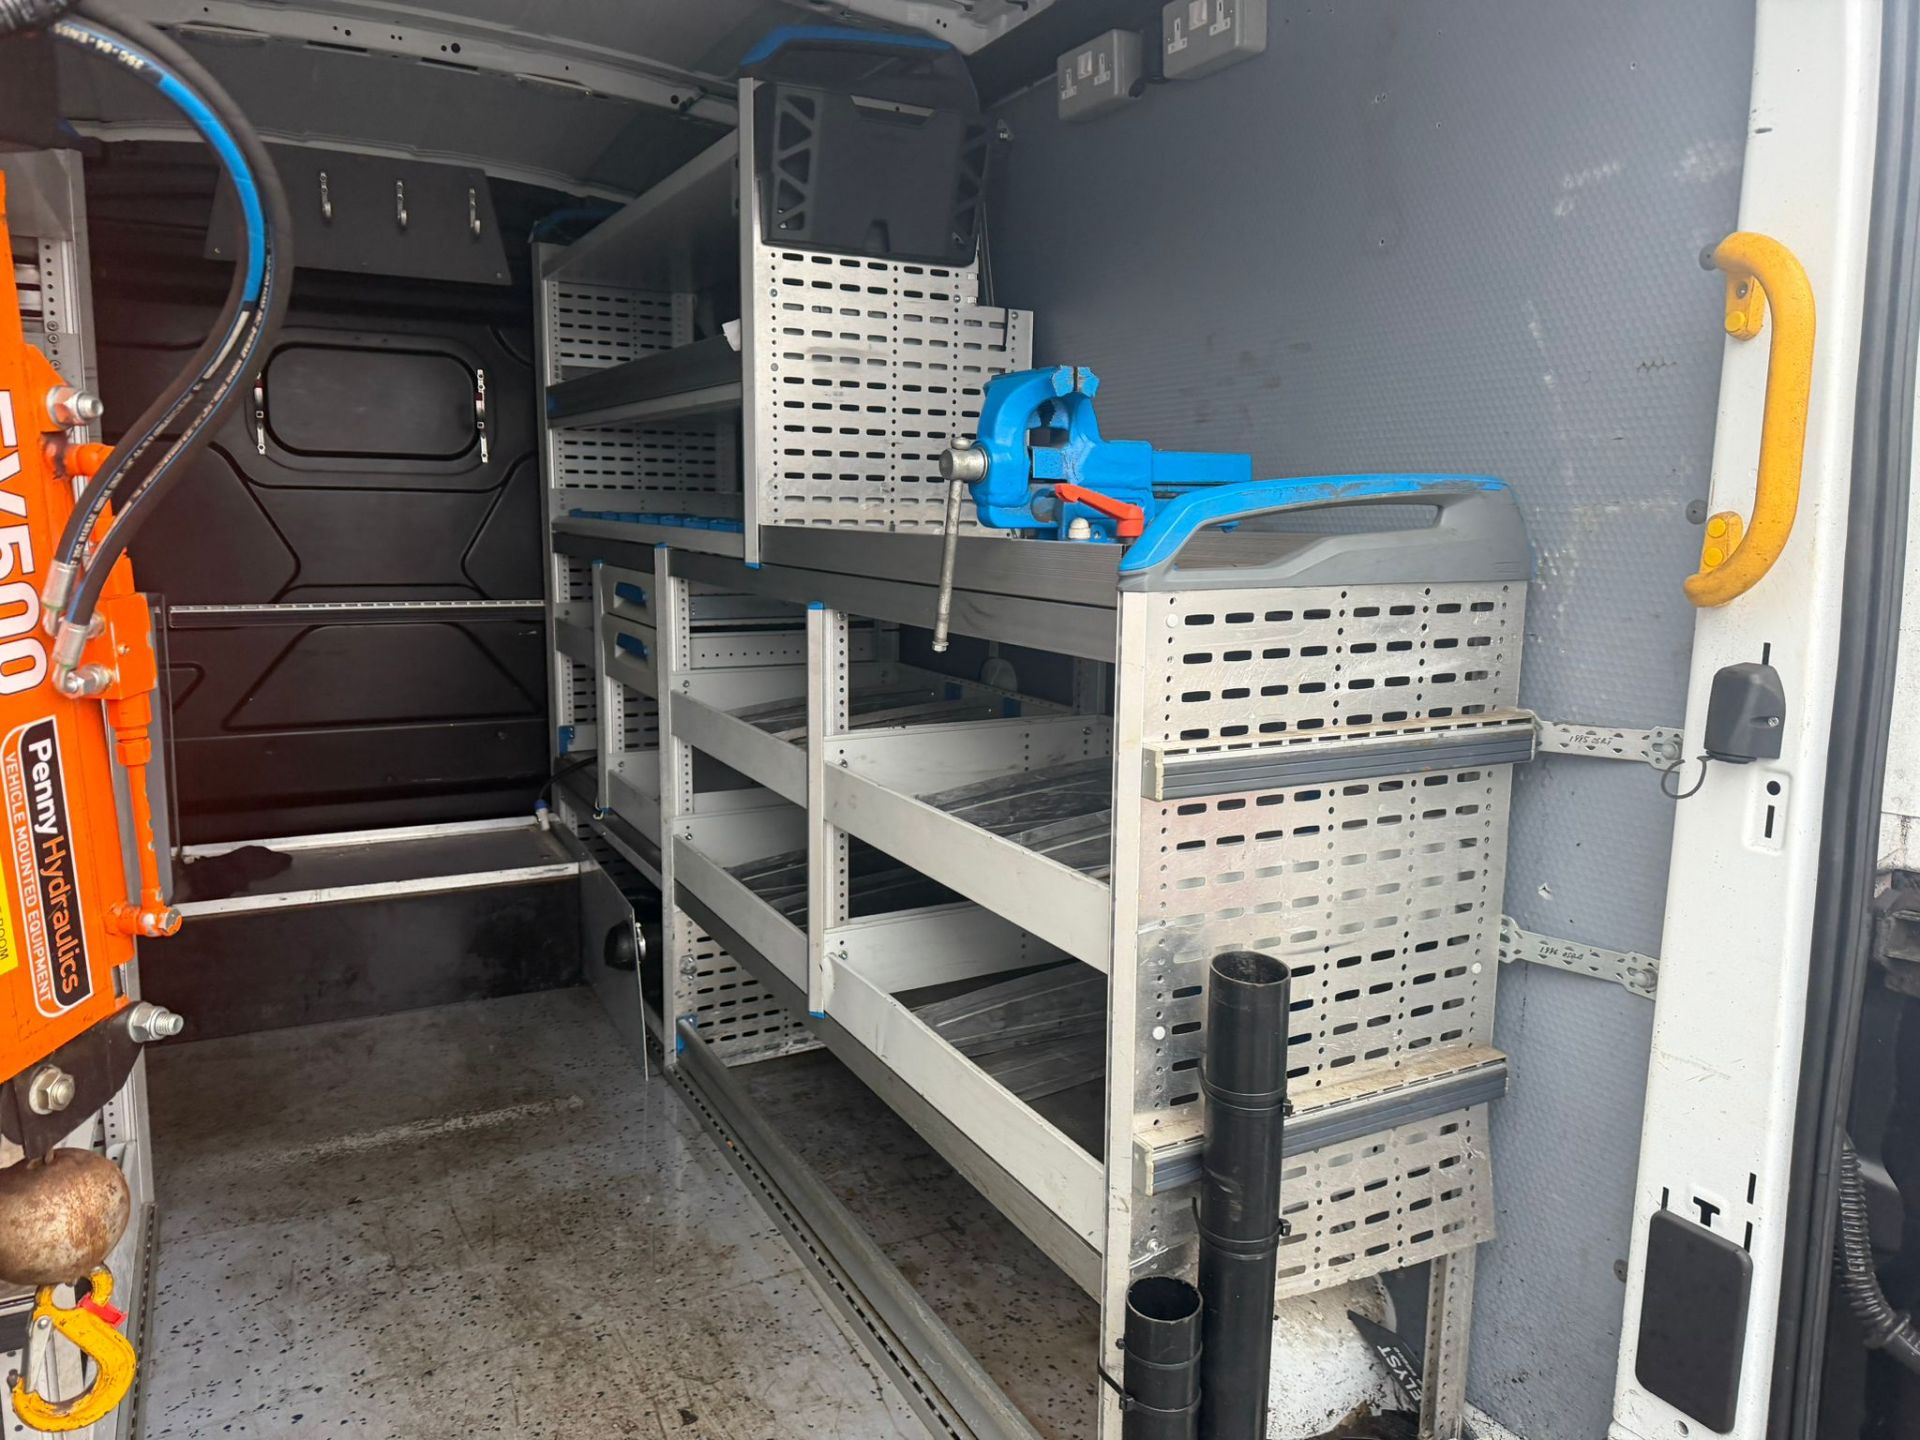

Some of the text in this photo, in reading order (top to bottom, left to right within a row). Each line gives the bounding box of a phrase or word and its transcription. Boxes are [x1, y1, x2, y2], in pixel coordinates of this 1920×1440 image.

[5, 752, 52, 1001] VEHICLE MOUNTED EQUIPMENT
[28, 738, 80, 994] Penny Hydraulics
